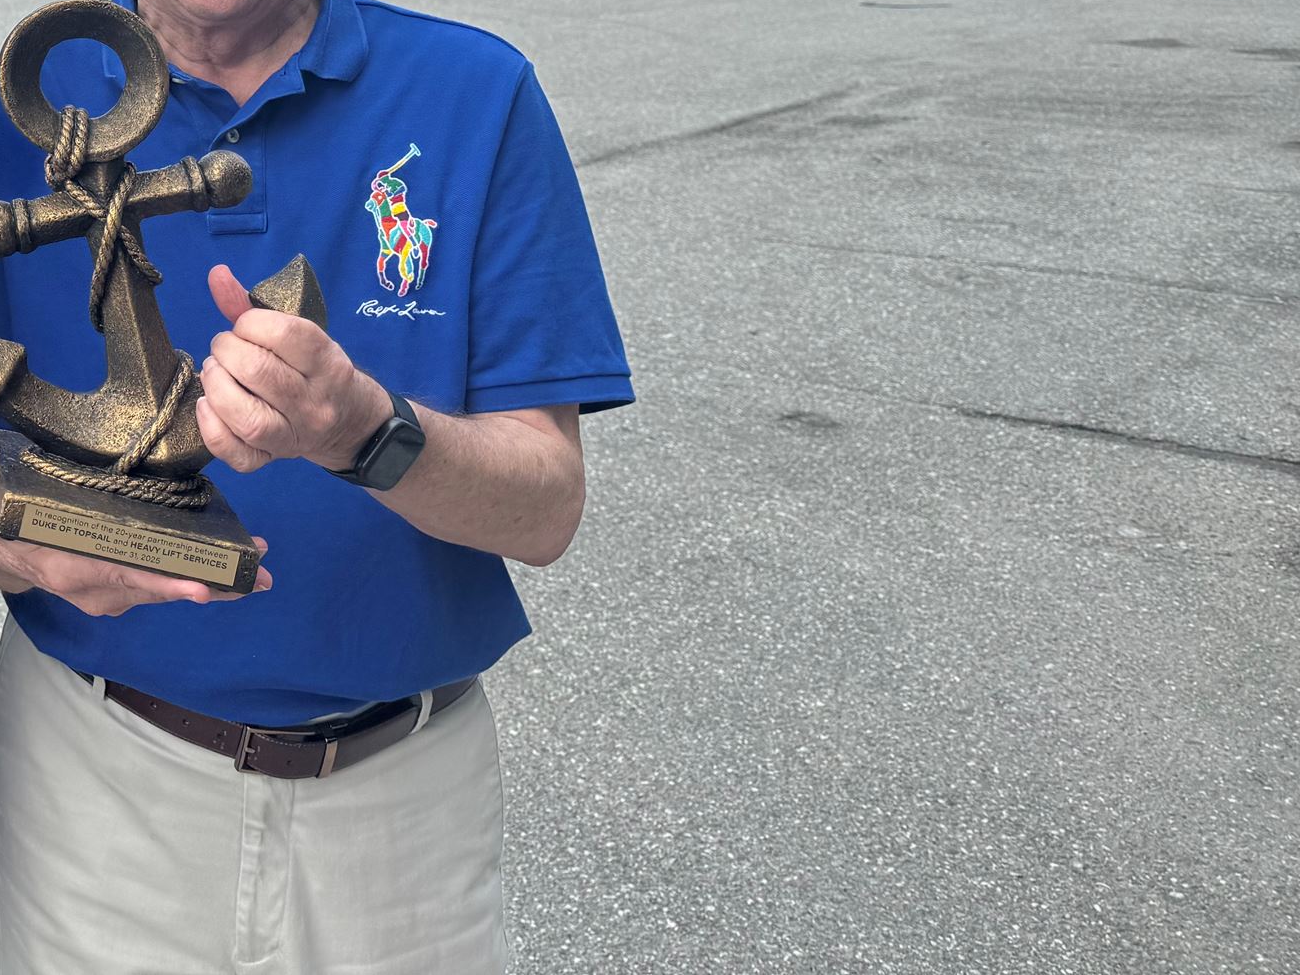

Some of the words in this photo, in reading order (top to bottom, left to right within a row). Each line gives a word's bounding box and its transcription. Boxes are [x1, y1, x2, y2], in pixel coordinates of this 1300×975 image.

[31, 518, 57, 530] DUKE
[58, 525, 72, 534] OF
[73, 528, 111, 543] TOPSAIL
[113, 538, 129, 547] and
[130, 541, 161, 554] HEAVY
[162, 548, 183, 559] LIFT
[183, 553, 228, 570] SERVICES
[44, 512, 89, 527] recognition
[91, 522, 99, 530] of
[101, 524, 114, 534] the
[115, 527, 146, 539] 20-year
[147, 536, 193, 552] partnership
[194, 546, 229, 560] between
[94, 543, 128, 556] October
[129, 551, 139, 560] 31,
[140, 553, 161, 565] 2025
